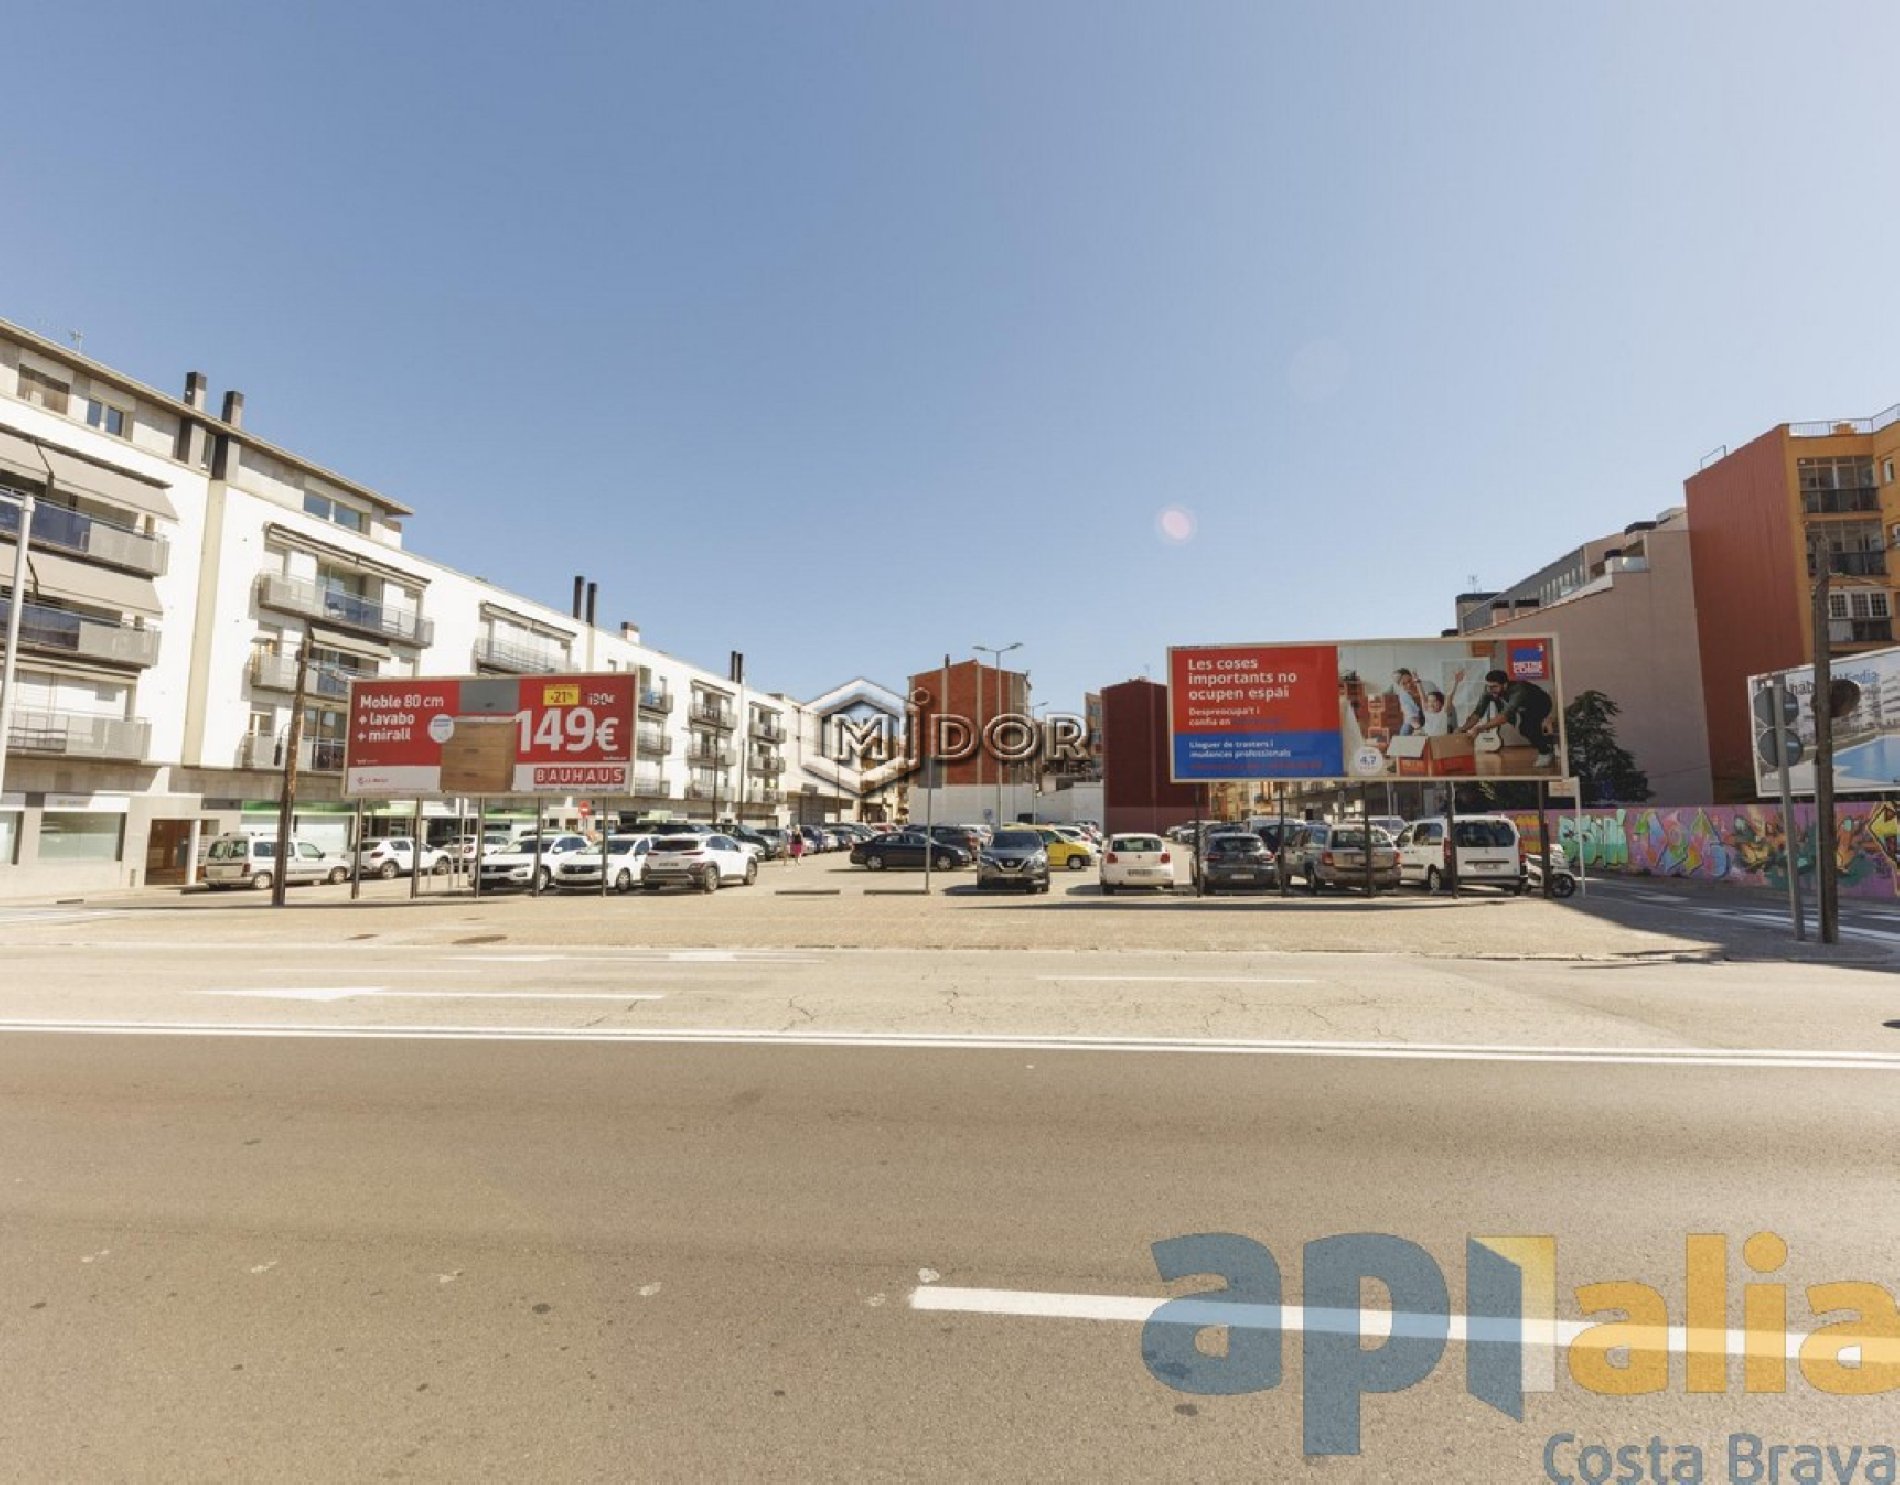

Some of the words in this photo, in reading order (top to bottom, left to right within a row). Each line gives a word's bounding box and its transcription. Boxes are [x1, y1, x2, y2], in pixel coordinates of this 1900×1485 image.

[1188, 659, 1212, 671] Les
[1217, 659, 1258, 670] coses
[1188, 673, 1273, 686] importants
[1279, 672, 1297, 683] no
[360, 694, 401, 708] Moble
[403, 694, 421, 707] 80
[423, 696, 444, 707] cm
[1189, 689, 1243, 703] ocupen
[1249, 686, 1290, 702] espai
[370, 711, 415, 725] lavabo
[369, 727, 411, 742] mirall
[536, 768, 624, 782] BAUHAUS
